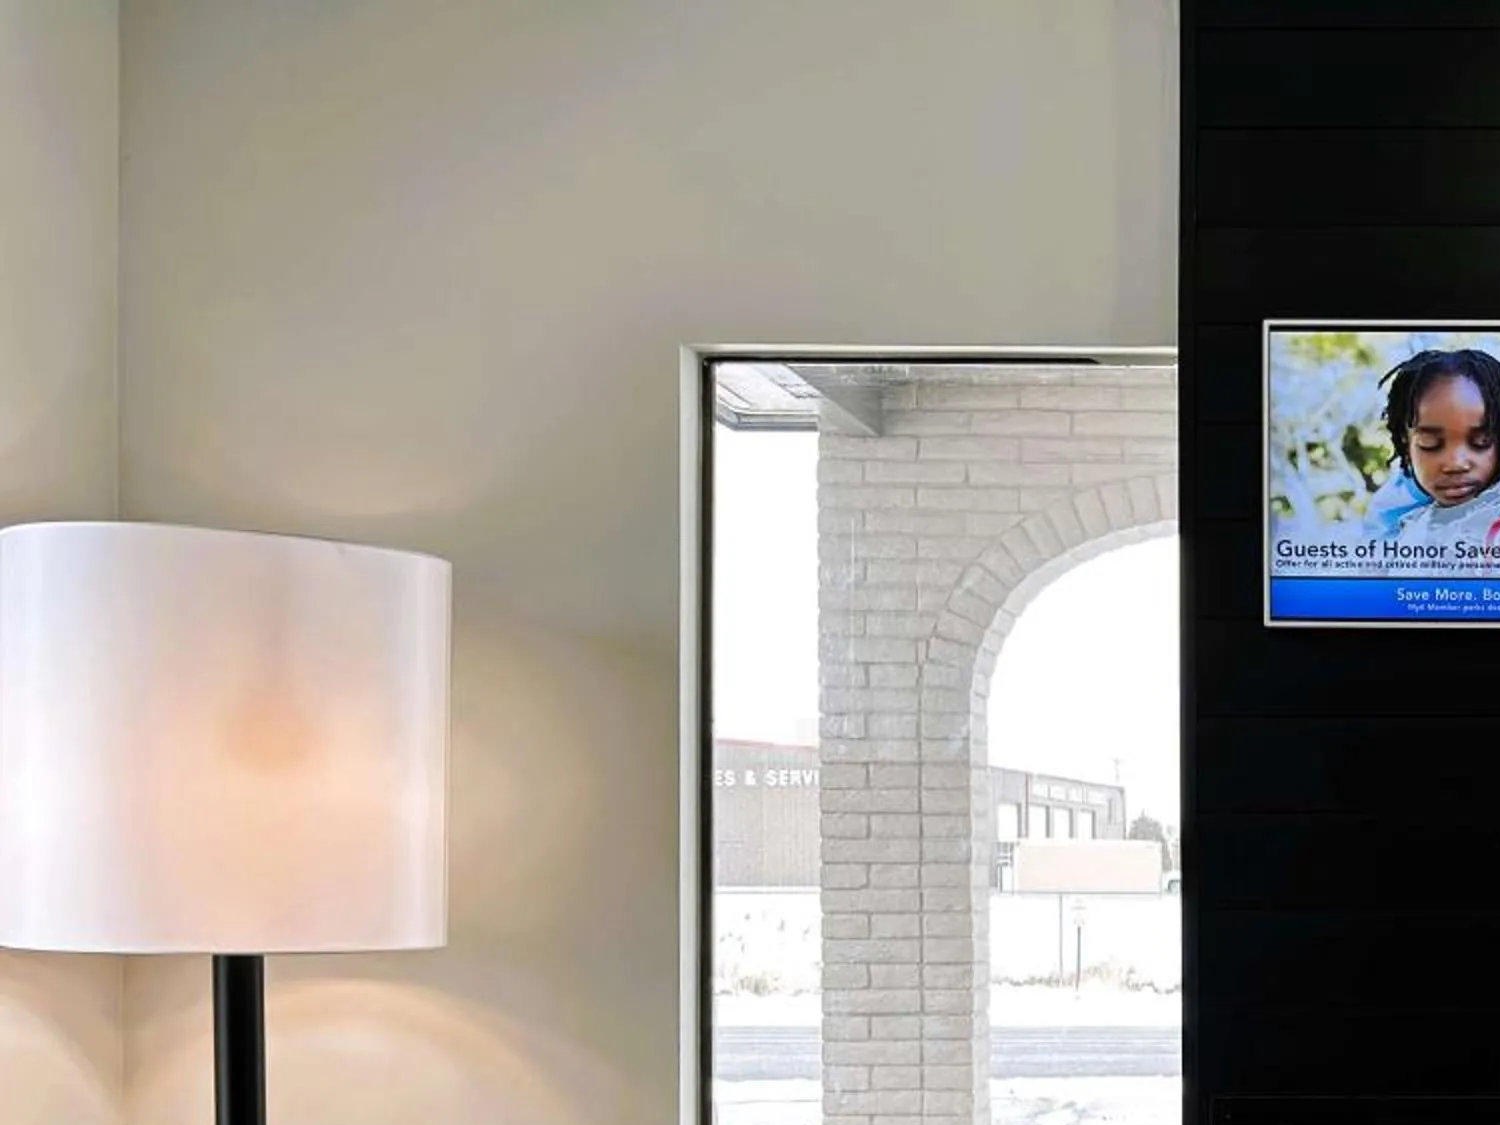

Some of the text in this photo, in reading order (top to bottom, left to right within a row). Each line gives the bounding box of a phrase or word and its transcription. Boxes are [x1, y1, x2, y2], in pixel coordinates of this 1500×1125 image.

[1276, 539, 1348, 557] Guests
[1355, 539, 1376, 558] of
[1383, 540, 1447, 558] Honor
[1276, 560, 1300, 568] Offer
[1303, 560, 1317, 568] for
[1396, 588, 1429, 600] Save
[1435, 588, 1477, 601] More.
